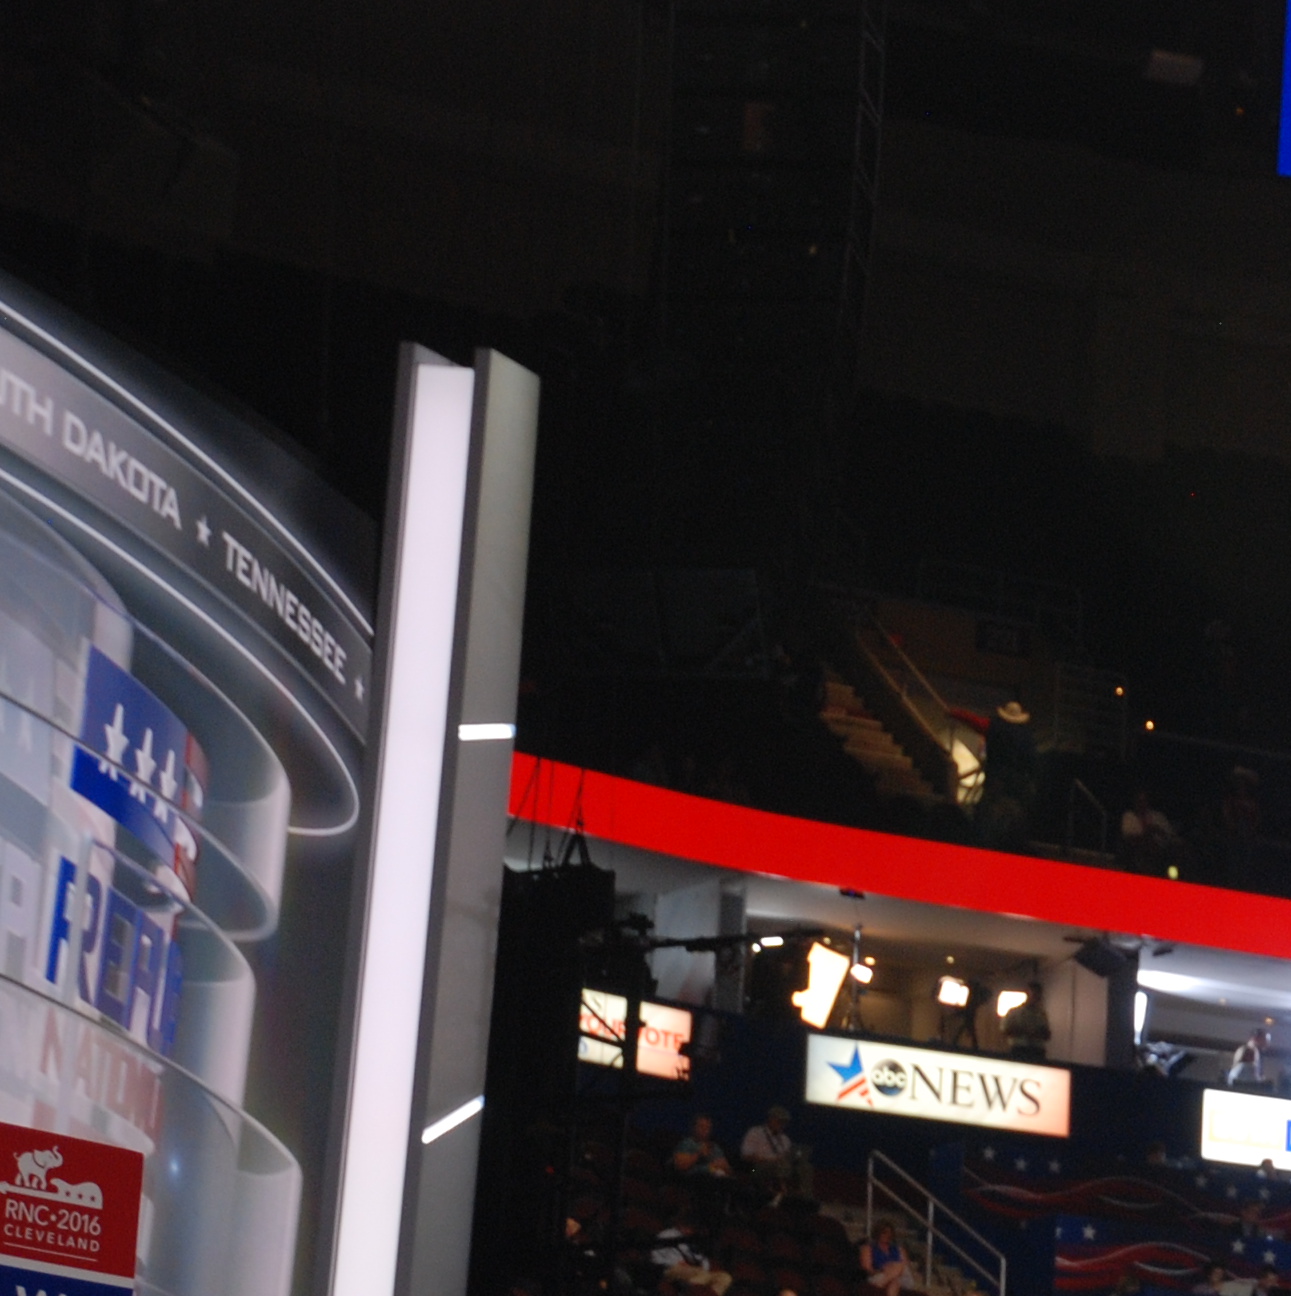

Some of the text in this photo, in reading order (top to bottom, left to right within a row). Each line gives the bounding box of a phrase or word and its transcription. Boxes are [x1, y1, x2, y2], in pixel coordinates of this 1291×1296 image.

[0, 367, 347, 685] TH DAKOTA TENNESSEE
[910, 1063, 1042, 1117] NEWS
[3, 1223, 101, 1253] CLEVELAND
[4, 1199, 102, 1236] RNC 2016
